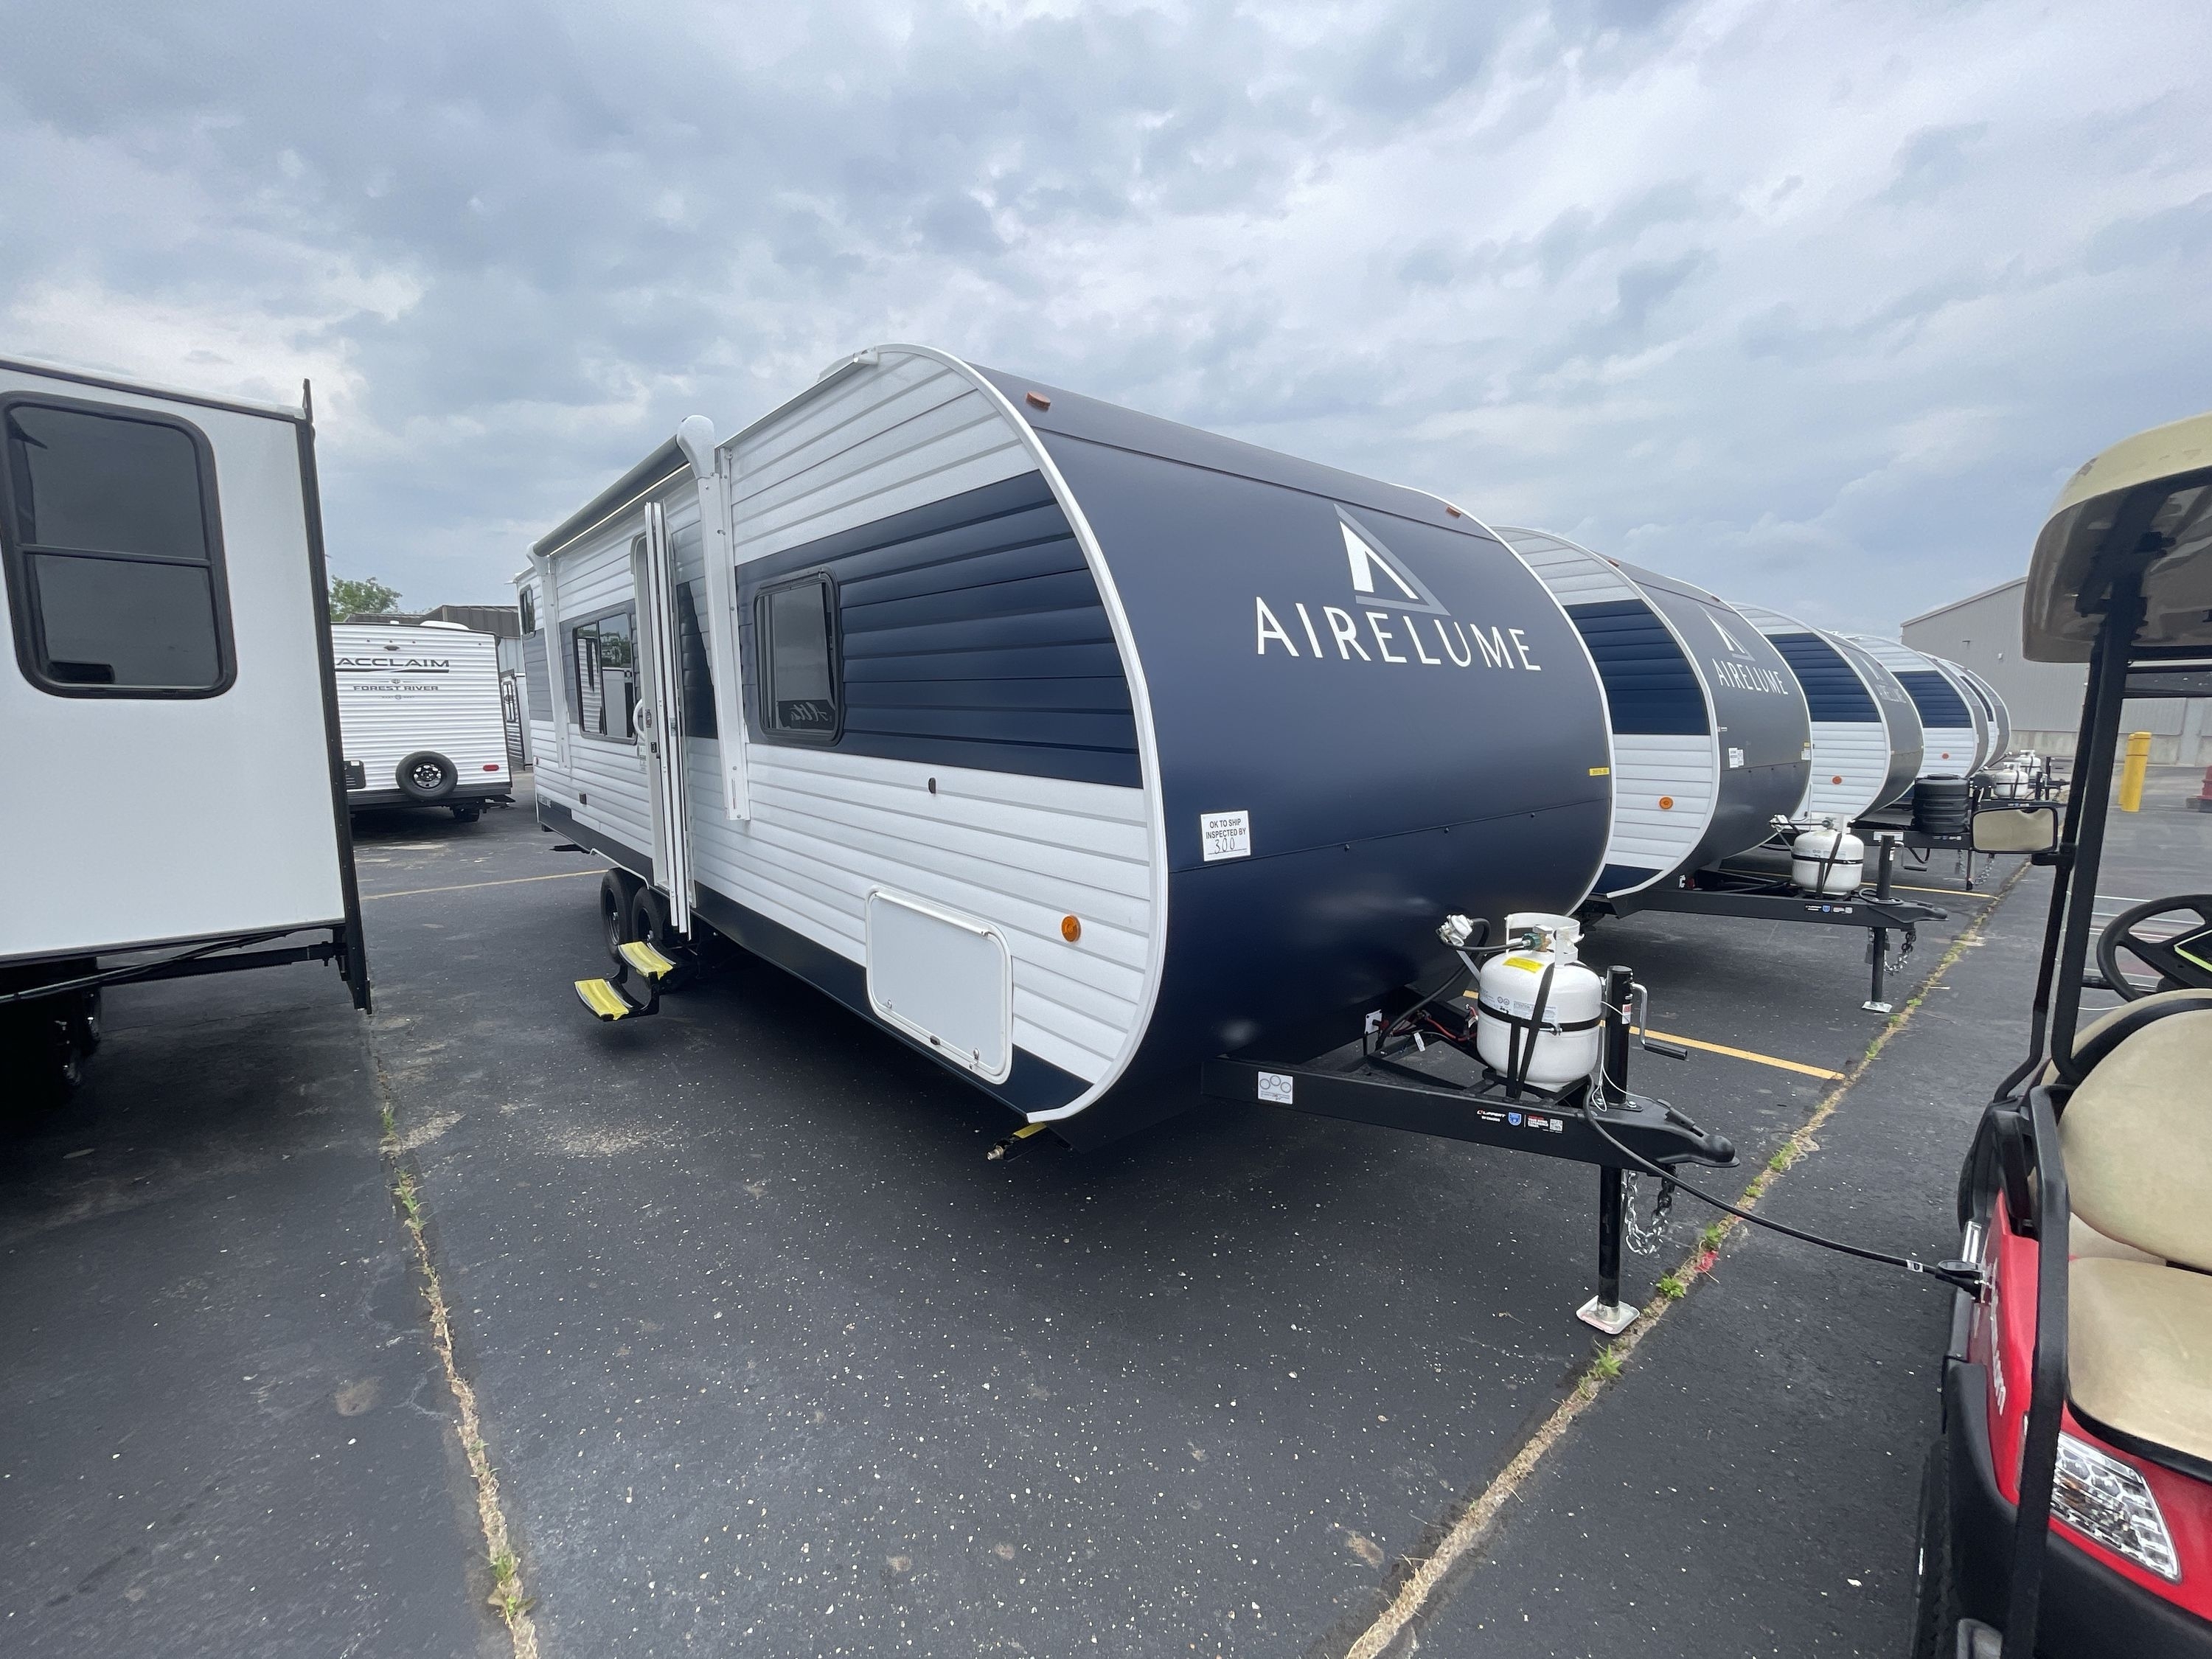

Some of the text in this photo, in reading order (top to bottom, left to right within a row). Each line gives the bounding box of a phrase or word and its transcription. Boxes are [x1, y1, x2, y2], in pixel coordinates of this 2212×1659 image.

[1256, 596, 1542, 672] AIRELUME
[336, 658, 450, 667] ACCLAIM
[1711, 658, 1789, 695] AIRELUME
[1209, 818, 1242, 829] OK TO SHIP
[1206, 827, 1246, 839] INSPECTED BY
[1214, 837, 1235, 855] 300
